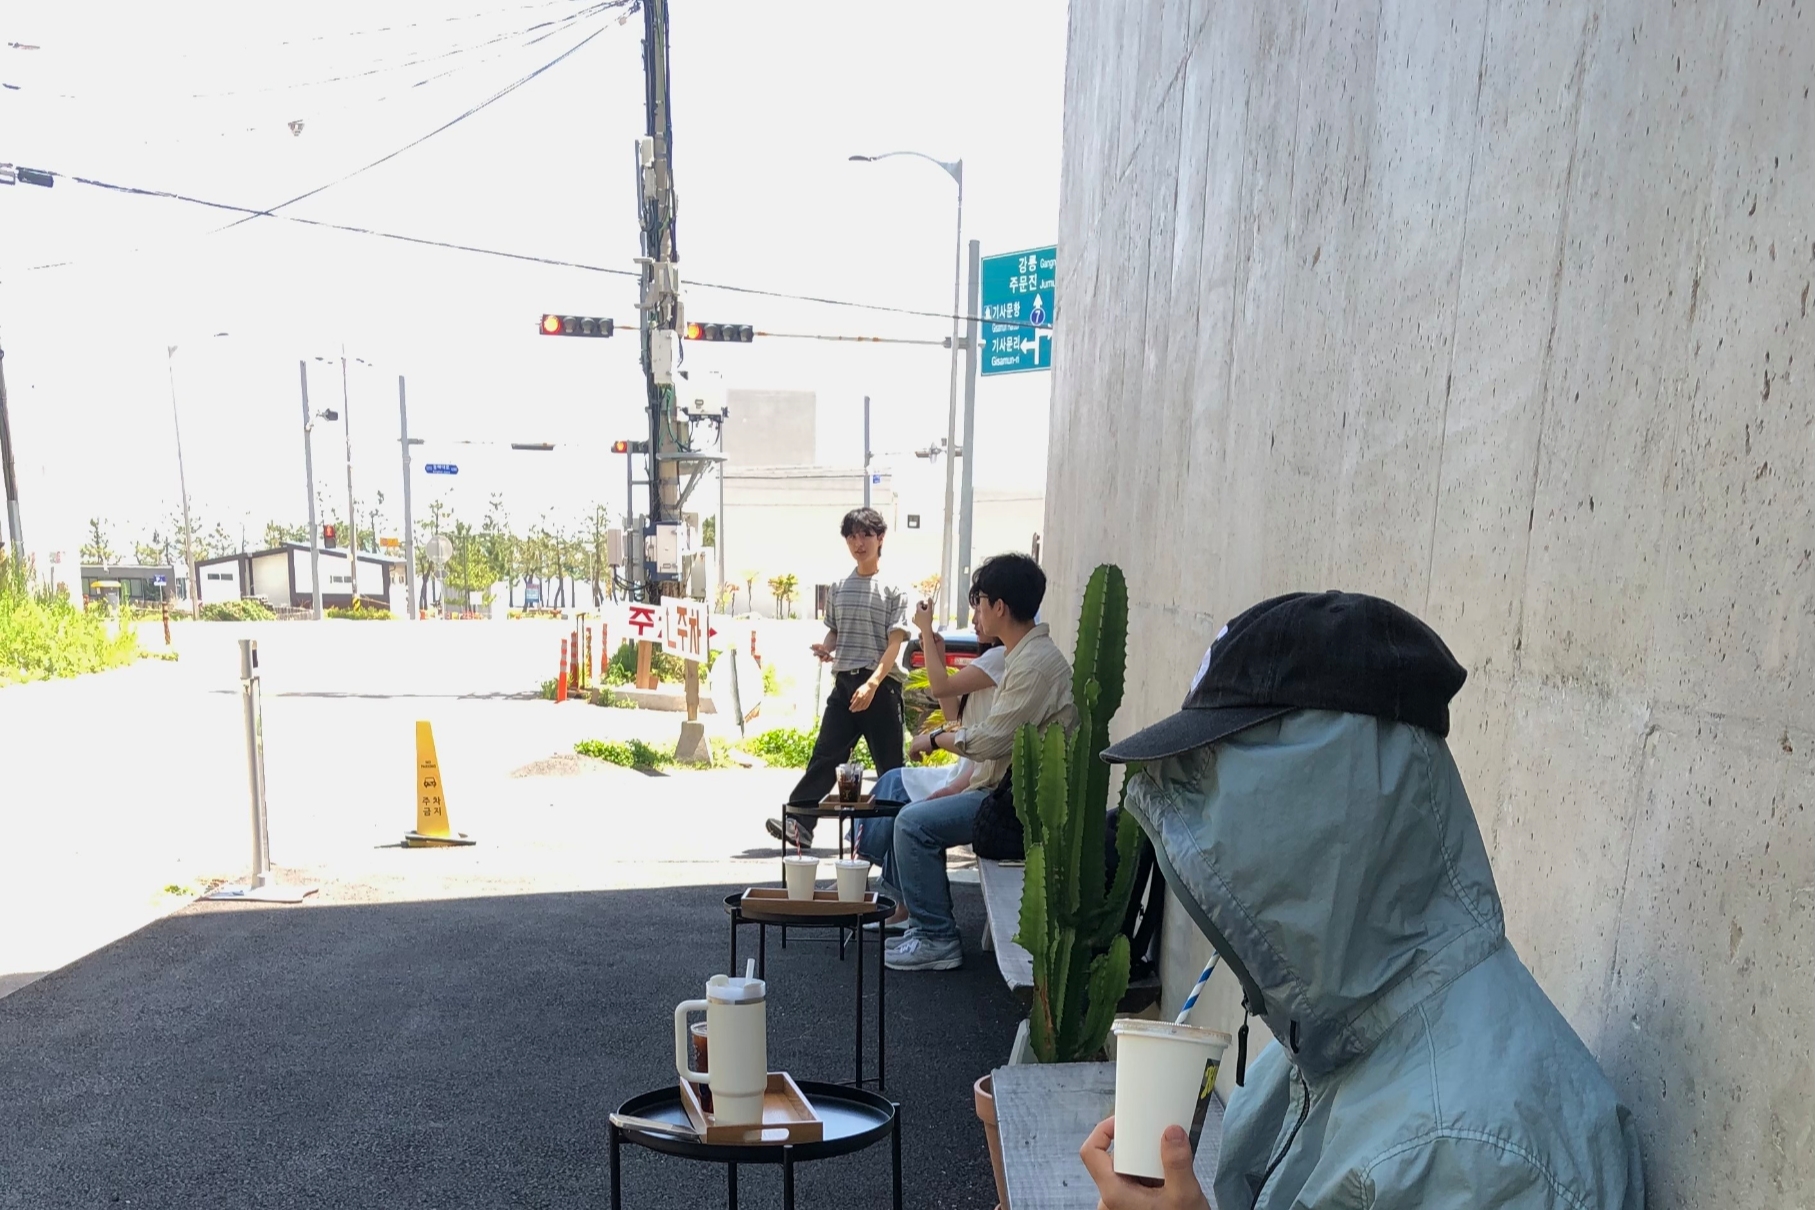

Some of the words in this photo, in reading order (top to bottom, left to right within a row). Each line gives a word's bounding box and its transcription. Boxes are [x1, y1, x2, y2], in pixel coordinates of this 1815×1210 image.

[1019, 254, 1037, 273] 강릉
[1009, 274, 1037, 293] 주문진
[992, 301, 1020, 319] 기사문항
[992, 335, 1020, 353] 기사문리
[991, 356, 1020, 366] Gisamun-ri
[628, 606, 662, 638] 주
